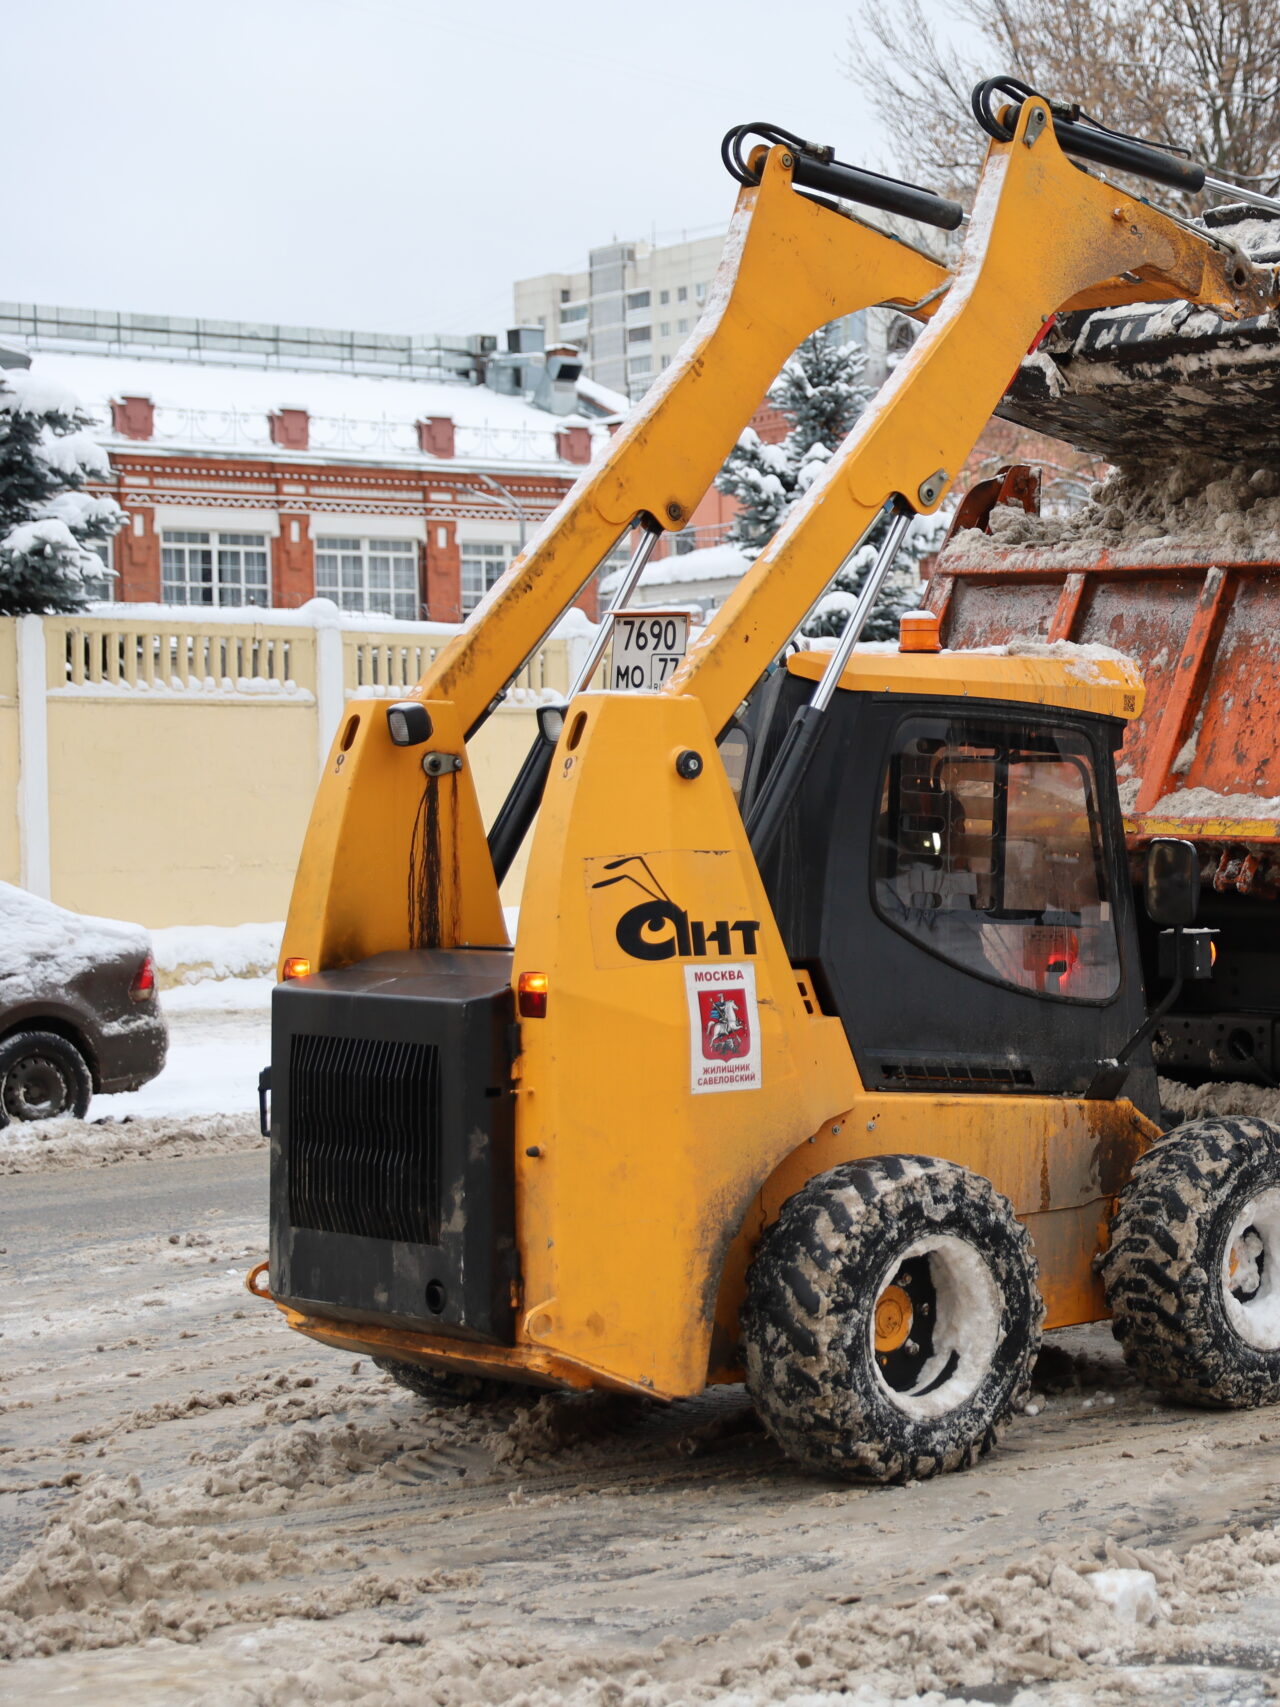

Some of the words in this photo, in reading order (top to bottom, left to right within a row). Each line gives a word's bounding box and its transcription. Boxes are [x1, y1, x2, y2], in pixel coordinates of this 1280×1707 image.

[623, 619, 677, 651] 7690
[615, 665, 645, 689] МО
[658, 657, 680, 681] 77
[694, 969, 744, 983] МОСКВА
[702, 1064, 750, 1075] ЖИЛИЩНИК
[697, 1073, 756, 1086] САВЕЛОВСКИЙ
